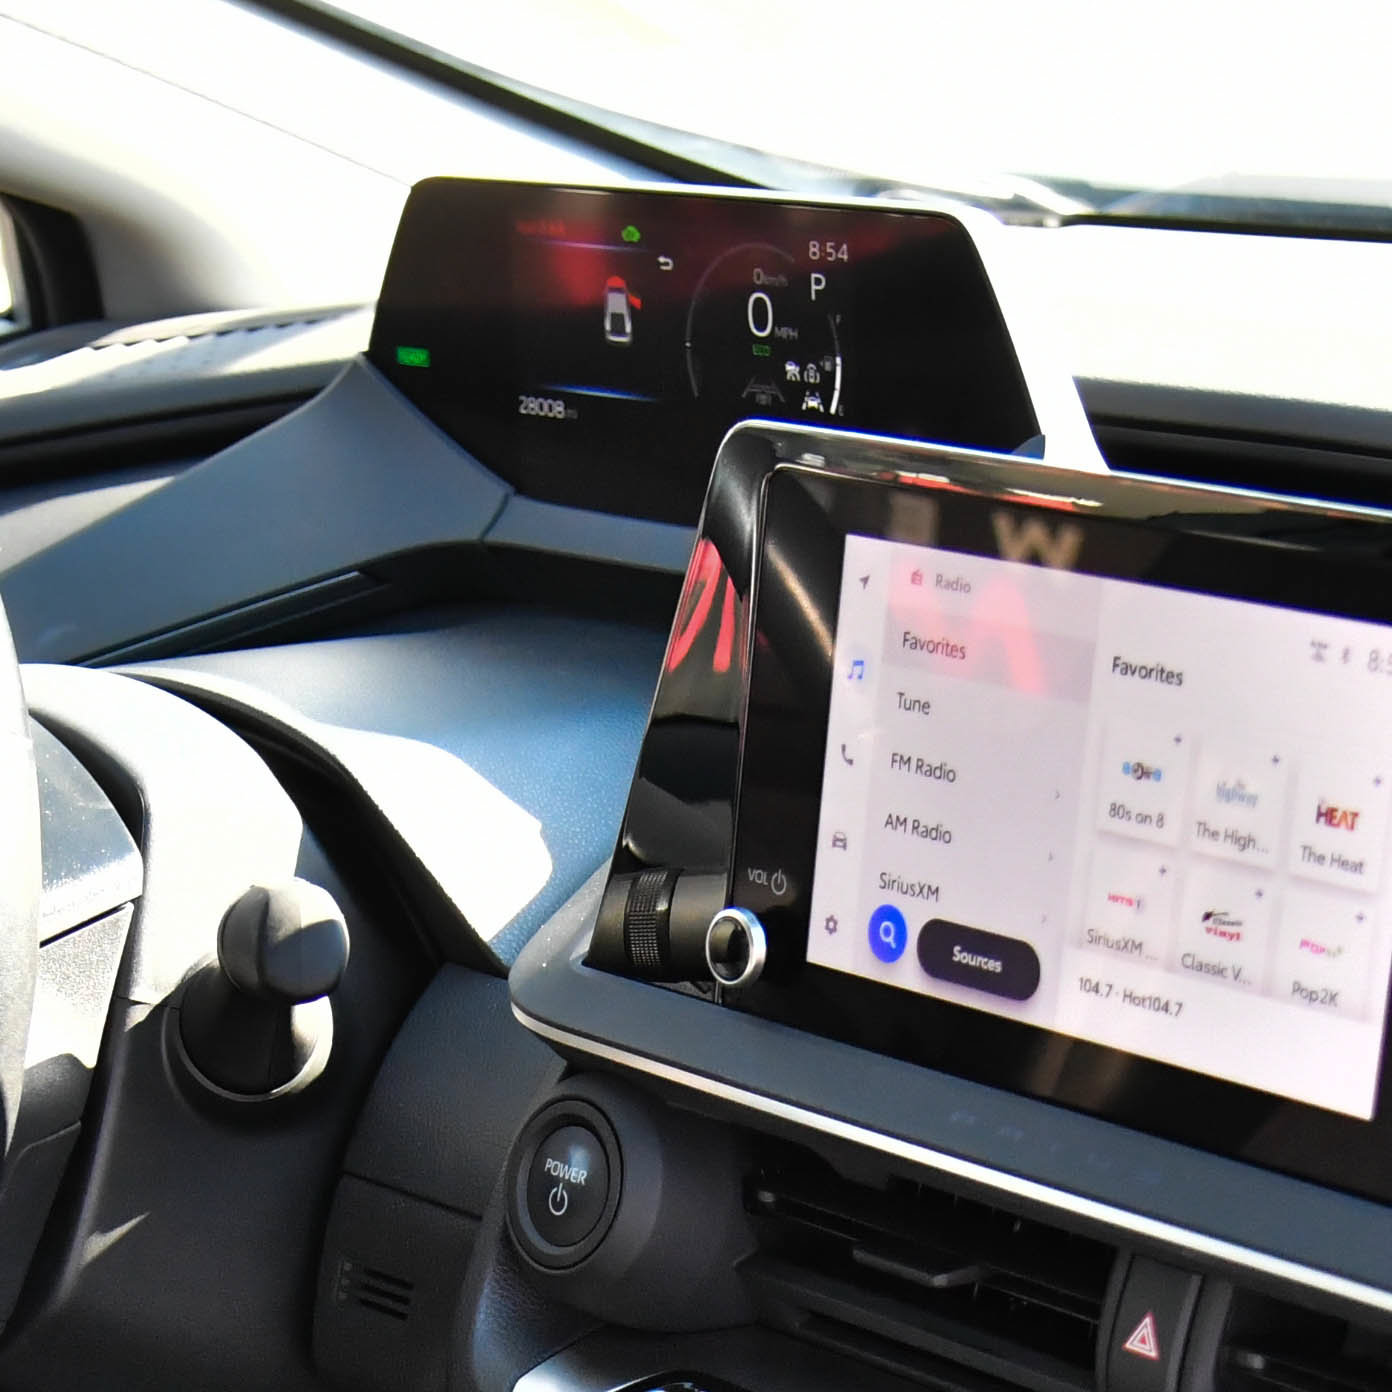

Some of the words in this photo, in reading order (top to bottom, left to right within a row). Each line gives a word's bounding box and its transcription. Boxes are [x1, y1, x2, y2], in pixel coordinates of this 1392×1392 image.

[808, 240, 849, 262] 8:54
[810, 272, 826, 301] P
[747, 290, 773, 337] 0
[518, 395, 565, 419] 28008
[935, 573, 972, 593] Radio
[902, 631, 966, 661] Favorites
[1111, 655, 1184, 687] Favorites
[896, 691, 931, 716] Tune
[890, 752, 913, 774] FM
[914, 757, 957, 784] Radio
[884, 813, 909, 835] AM
[911, 819, 953, 845] Radio
[1108, 802, 1132, 822] 80s
[1135, 812, 1153, 826] on
[1155, 813, 1165, 830] 8
[1316, 803, 1360, 832] HEAT
[1196, 821, 1220, 842] The
[1301, 844, 1327, 867] The
[1329, 852, 1365, 876] Heat
[747, 866, 769, 886] VOL
[878, 871, 941, 903] SiriusXM
[1086, 928, 1144, 956] SiriusXM
[951, 945, 1003, 973] Sources
[1180, 952, 1229, 979] Classic
[1079, 976, 1113, 998] 104.7
[1121, 987, 1184, 1018] Hot104.7
[1291, 980, 1340, 1007] Pop2K
[543, 1157, 589, 1187] POWER
